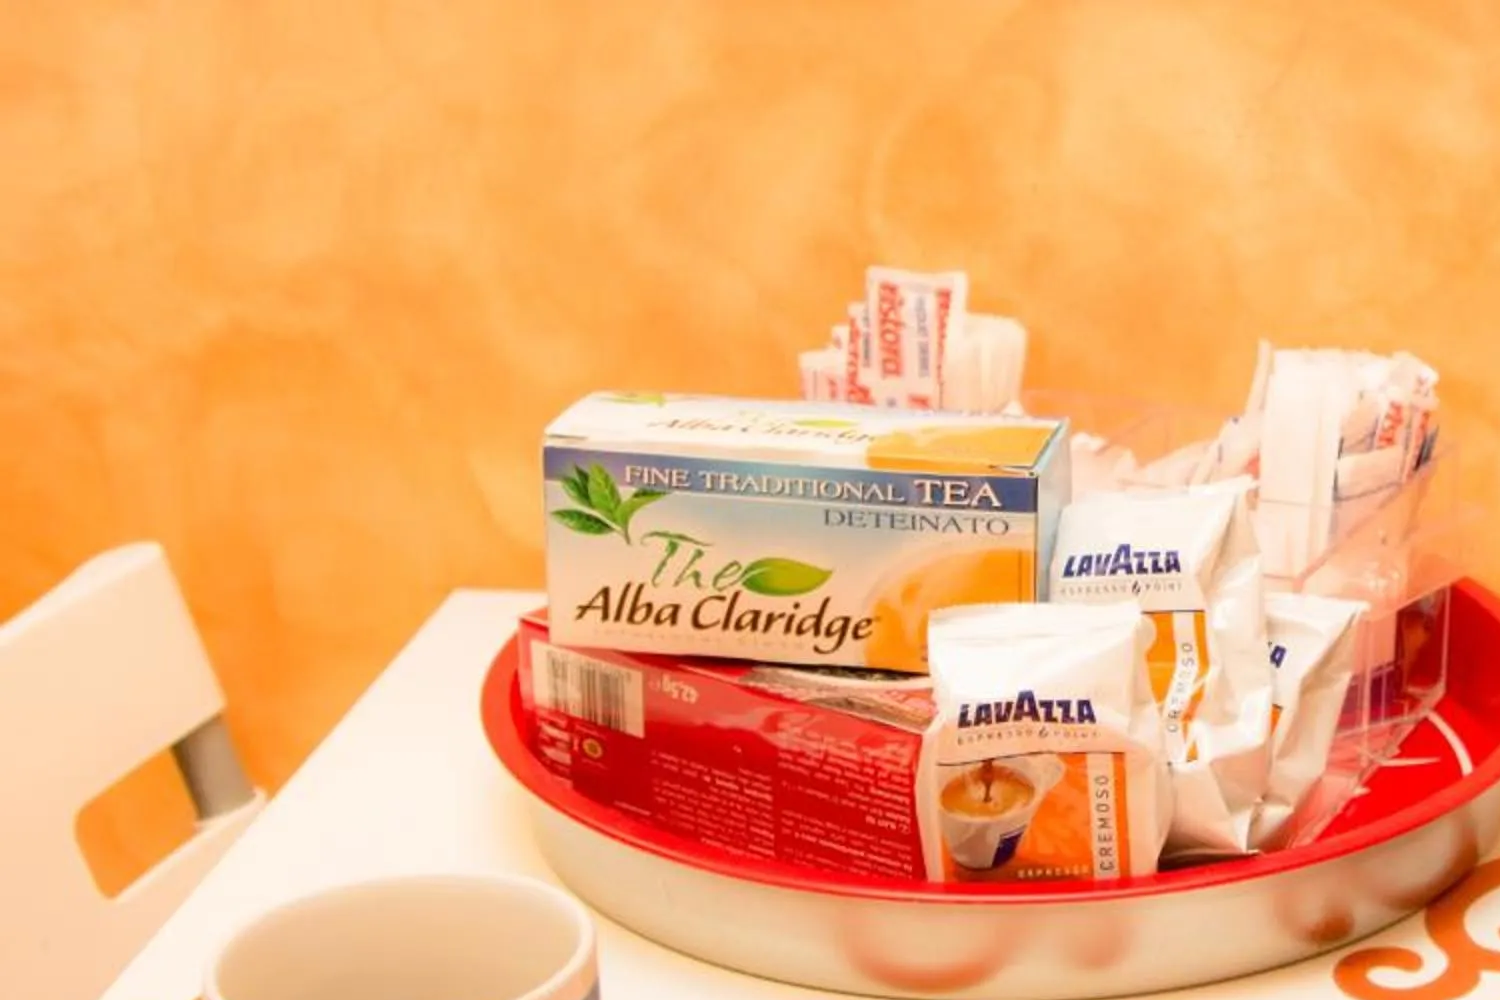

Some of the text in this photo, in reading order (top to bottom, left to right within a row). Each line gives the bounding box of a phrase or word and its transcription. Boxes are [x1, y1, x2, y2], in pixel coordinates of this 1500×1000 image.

[624, 465, 1003, 508] FINE TRADITIONAL TEA
[823, 508, 1010, 536] DETEINATO
[640, 530, 744, 592] The
[1061, 543, 1181, 578] LAVAZZA
[574, 584, 880, 655] Alba Claridge
[957, 689, 1097, 729] LAVAZZA
[1094, 774, 1115, 871] CREMOSO
